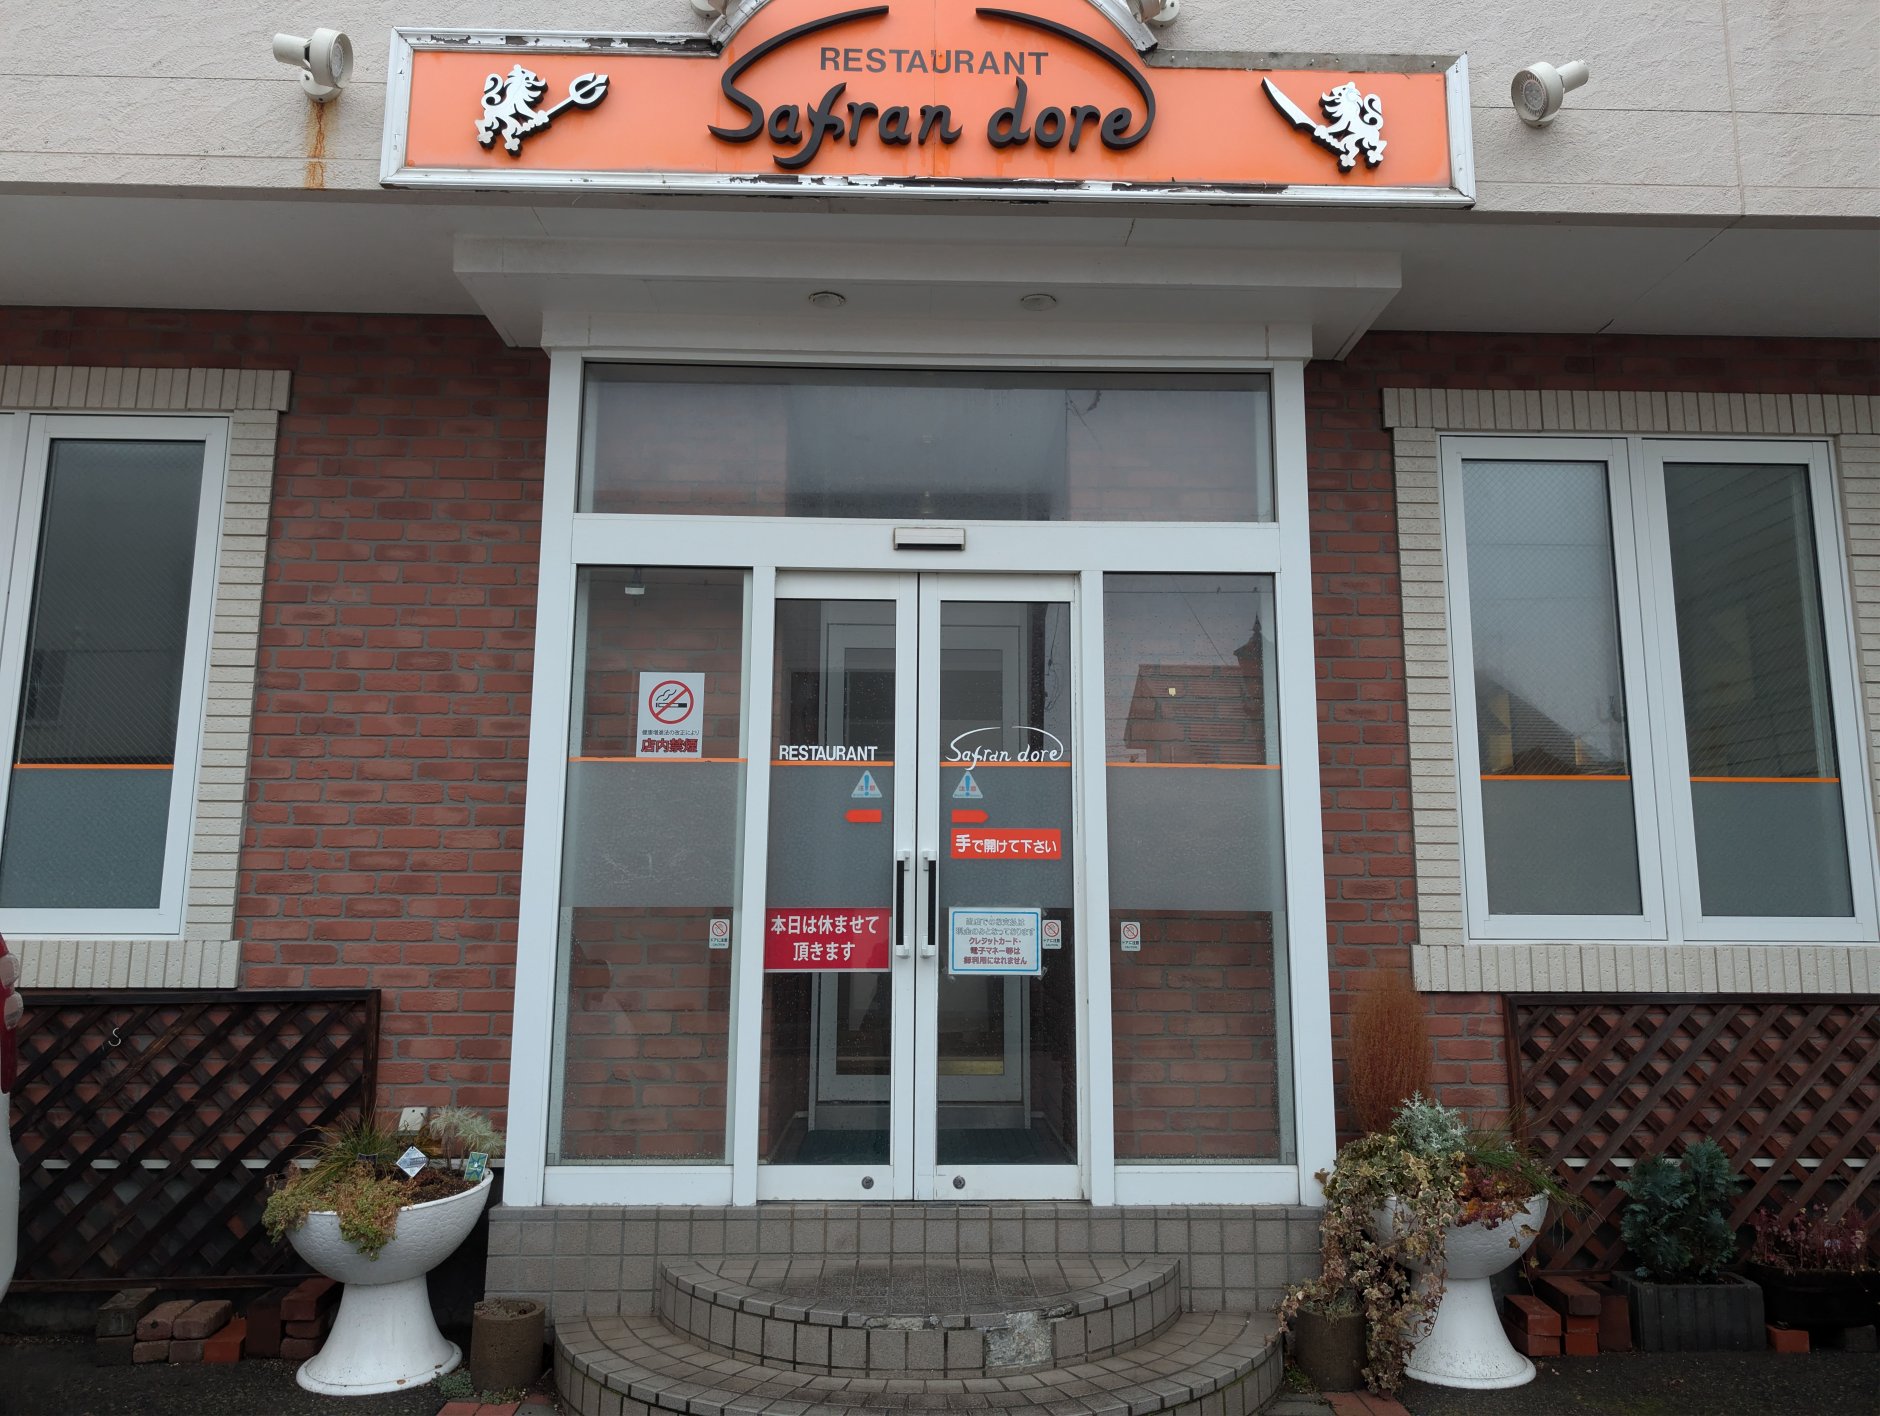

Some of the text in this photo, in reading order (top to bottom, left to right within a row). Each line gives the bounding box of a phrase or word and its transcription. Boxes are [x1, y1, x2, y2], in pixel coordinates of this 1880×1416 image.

[819, 46, 1049, 76] RESTAURANT
[707, 5, 963, 170] Safran
[640, 737, 699, 753] 店内禁煙
[779, 744, 879, 761] RESTAURANT
[945, 726, 1011, 771] Safran
[956, 833, 1057, 854] 手で開けて下さい
[771, 914, 880, 935] 本日は休ませて
[793, 941, 856, 961] 頂きます
